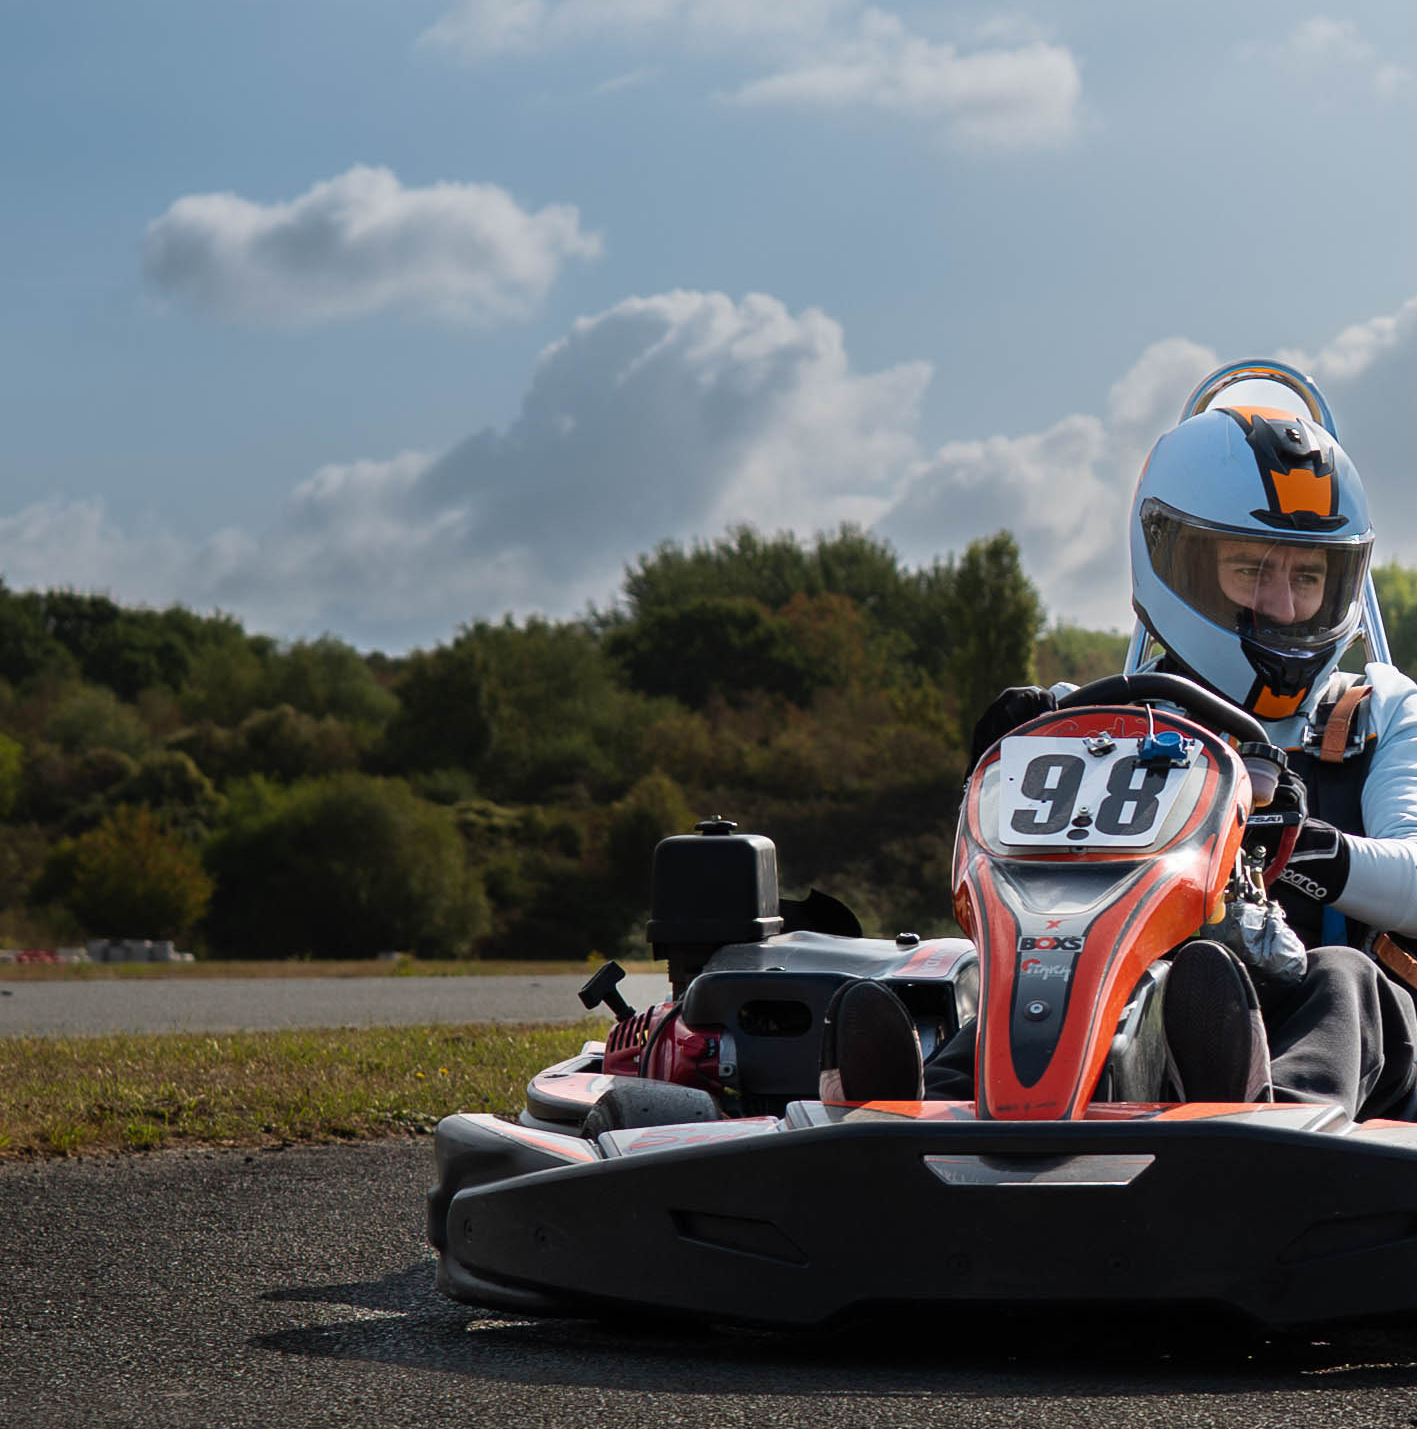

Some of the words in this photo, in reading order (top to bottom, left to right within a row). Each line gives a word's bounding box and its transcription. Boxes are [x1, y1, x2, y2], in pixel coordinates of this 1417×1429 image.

[1011, 754, 1169, 836] 98
[1280, 868, 1328, 898] parco
[1020, 936, 1082, 950] BOXS
